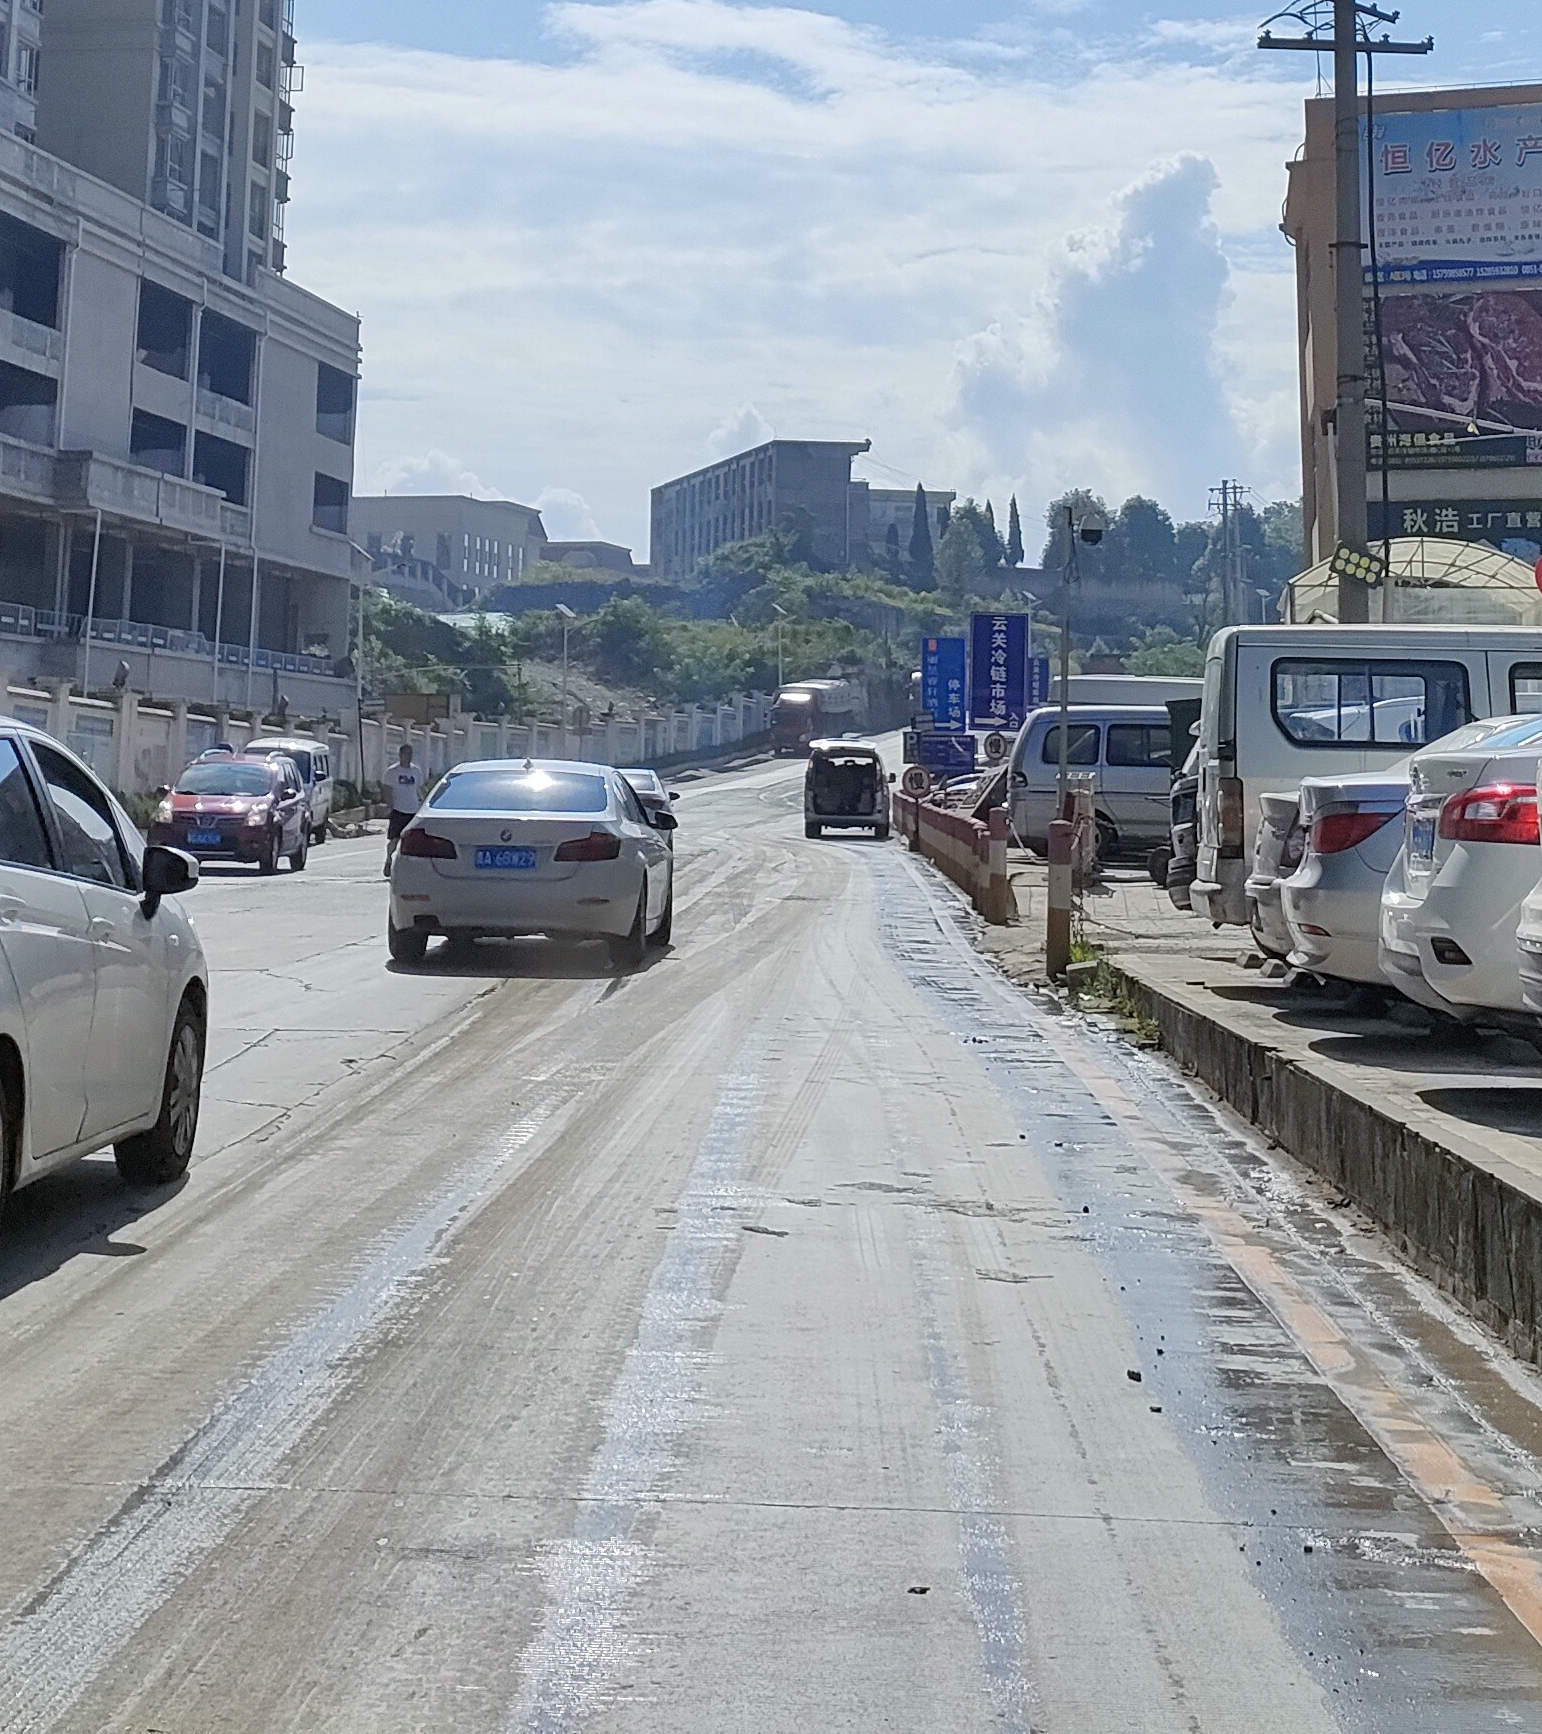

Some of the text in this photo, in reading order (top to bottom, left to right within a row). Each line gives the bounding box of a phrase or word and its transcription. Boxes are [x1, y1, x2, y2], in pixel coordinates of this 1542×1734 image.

[1403, 508, 1459, 533] 秋浩
[990, 617, 1008, 715] 云关冷链市场
[948, 679, 961, 717] 停车场
